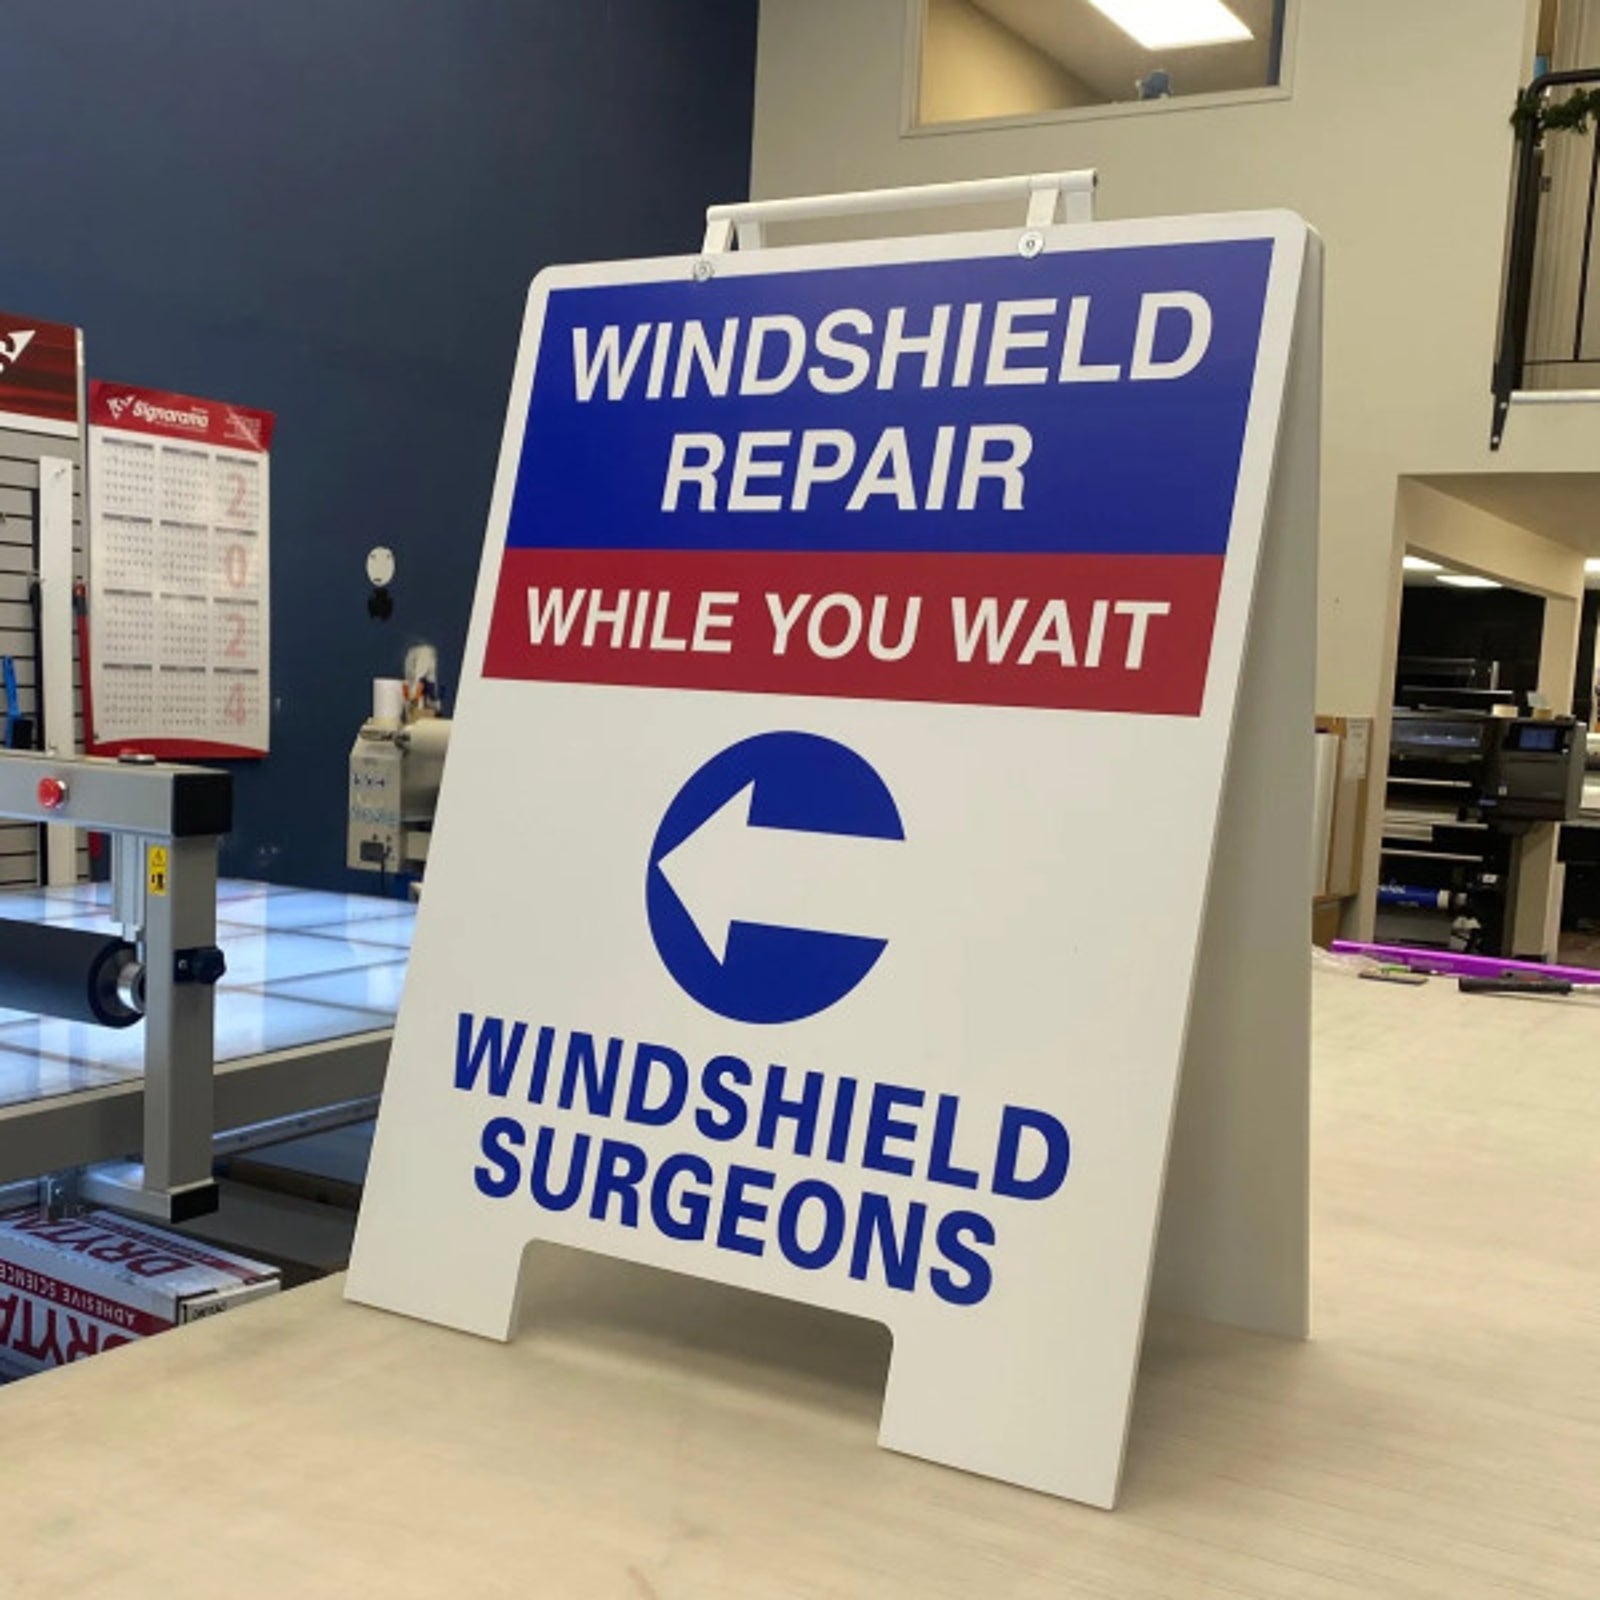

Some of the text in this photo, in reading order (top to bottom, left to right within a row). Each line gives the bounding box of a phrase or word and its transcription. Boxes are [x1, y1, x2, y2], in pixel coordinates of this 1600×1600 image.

[572, 290, 1213, 402] WINDSHIELD
[661, 423, 1034, 512] REPAIR
[527, 587, 1171, 671] WHILE YOU WAIT
[453, 1013, 1071, 1202] WINDSHIELD
[474, 1117, 995, 1307] SURGEONS
[62, 1288, 136, 1327] ADHESIVE
